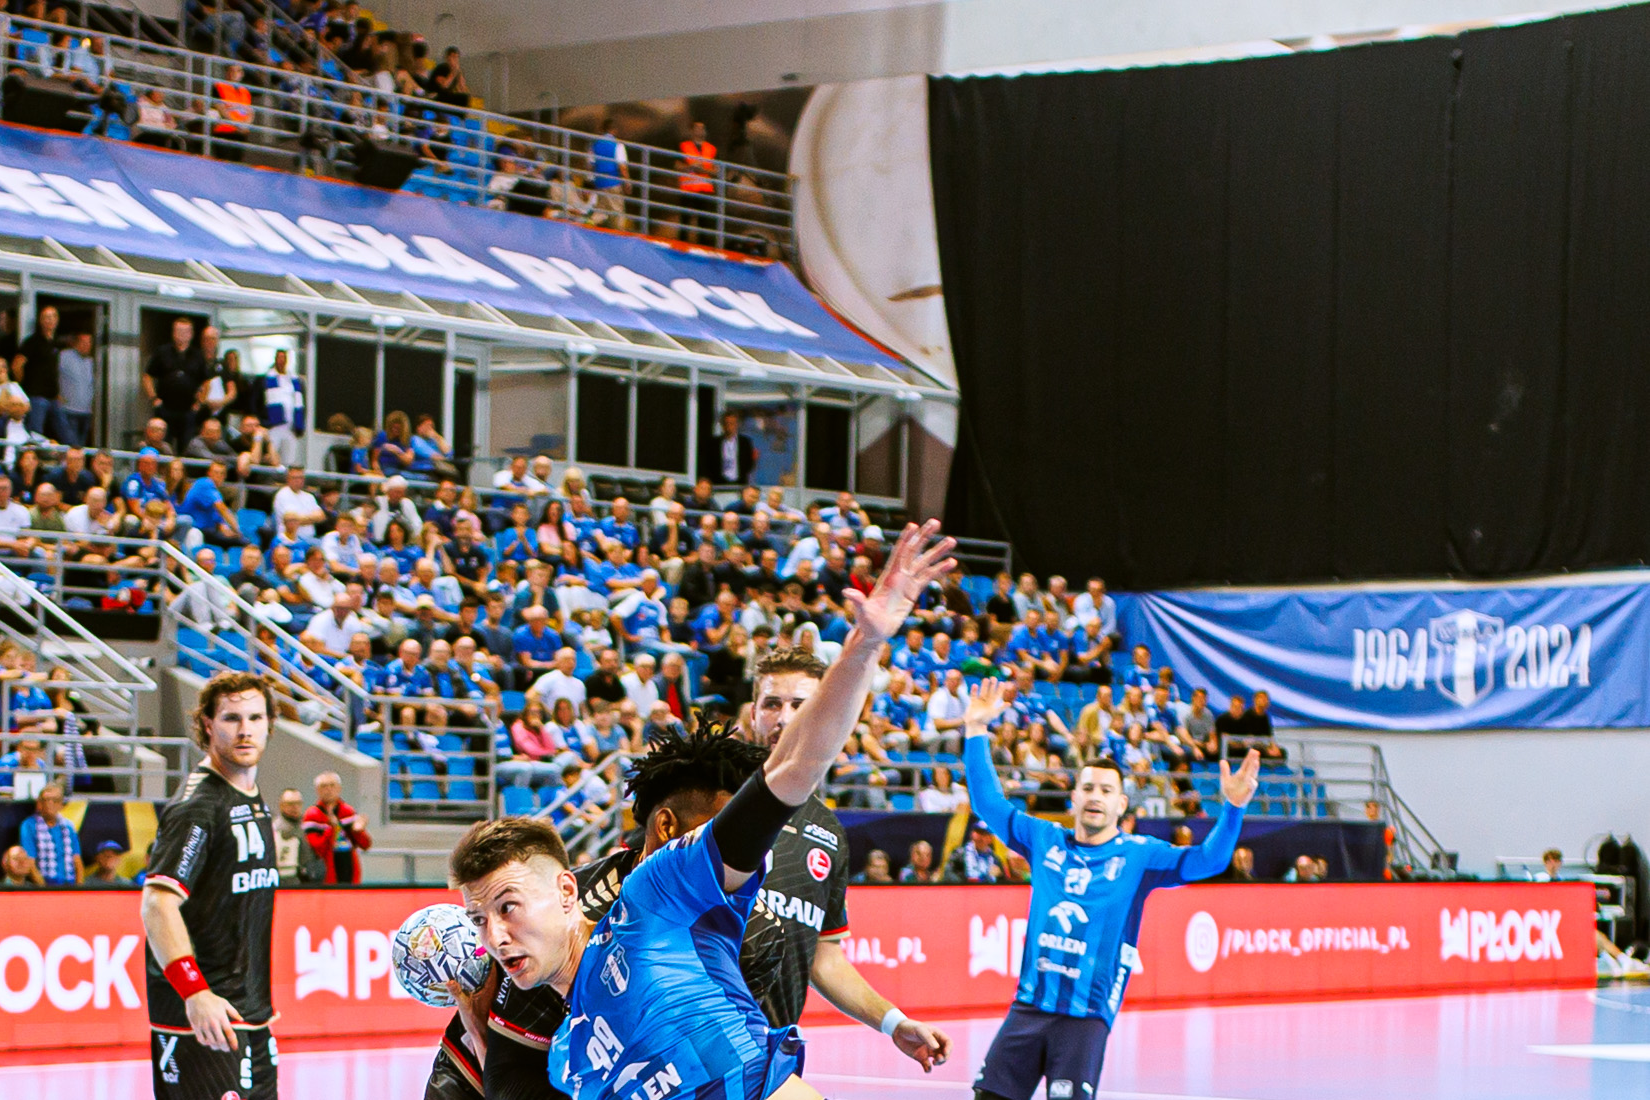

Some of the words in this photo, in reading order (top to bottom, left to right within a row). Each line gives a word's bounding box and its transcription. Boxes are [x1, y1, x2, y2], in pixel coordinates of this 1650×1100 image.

[152, 188, 520, 291] WISŁA
[486, 245, 821, 340] PŁOCK
[1351, 627, 1428, 692] 1964
[1505, 623, 1592, 690] 2024
[230, 821, 265, 863] 14
[1064, 867, 1093, 896] 23
[1037, 932, 1088, 956] ORLEN
[1469, 908, 1564, 962] PŁOCK
[586, 1015, 625, 1081] 99
